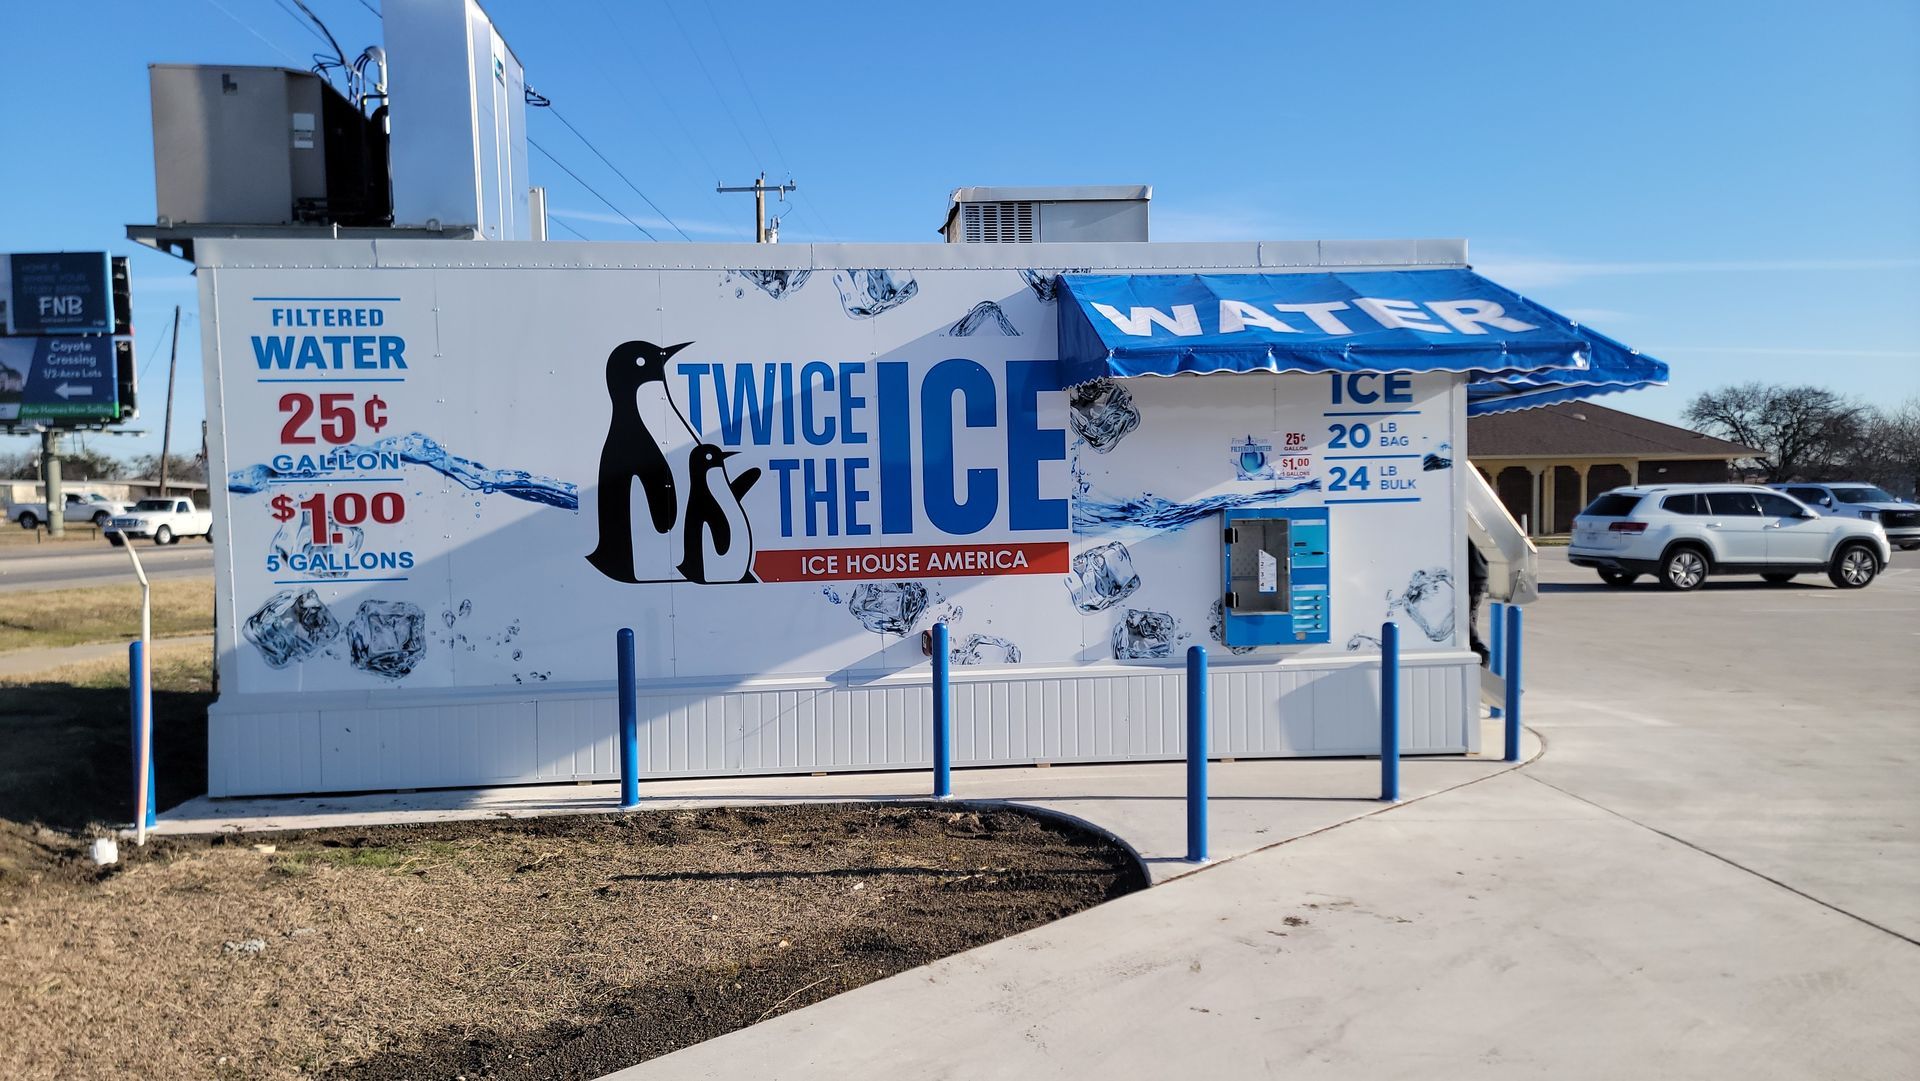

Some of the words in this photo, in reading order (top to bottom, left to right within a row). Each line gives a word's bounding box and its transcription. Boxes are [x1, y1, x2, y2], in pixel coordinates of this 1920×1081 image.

[38, 296, 83, 316] FNB
[272, 308, 384, 327] FILTERED
[1090, 297, 1540, 336] WATER
[51, 340, 92, 353] Coyote
[251, 336, 408, 370] WATER
[47, 353, 97, 368] Crossing
[82, 368, 102, 378] Lots
[1331, 372, 1413, 405] ICE
[677, 361, 868, 446] TWICE
[1328, 423, 1370, 449] 20
[1380, 423, 1397, 433] LB
[877, 358, 1070, 535] ICE
[1380, 436, 1409, 447] BAG
[272, 453, 399, 472] GALLON
[1282, 458, 1310, 470] $1.00
[1380, 466, 1397, 477] LB
[1328, 466, 1370, 491] 24
[1380, 479, 1416, 490] BULK
[769, 457, 872, 538] THE
[270, 491, 405, 545] $1.00
[266, 555, 280, 572] 5
[289, 551, 415, 572] GALLONS
[801, 555, 839, 575] ICE
[846, 553, 920, 574] HOUSE
[926, 550, 1029, 571] AMERICA
